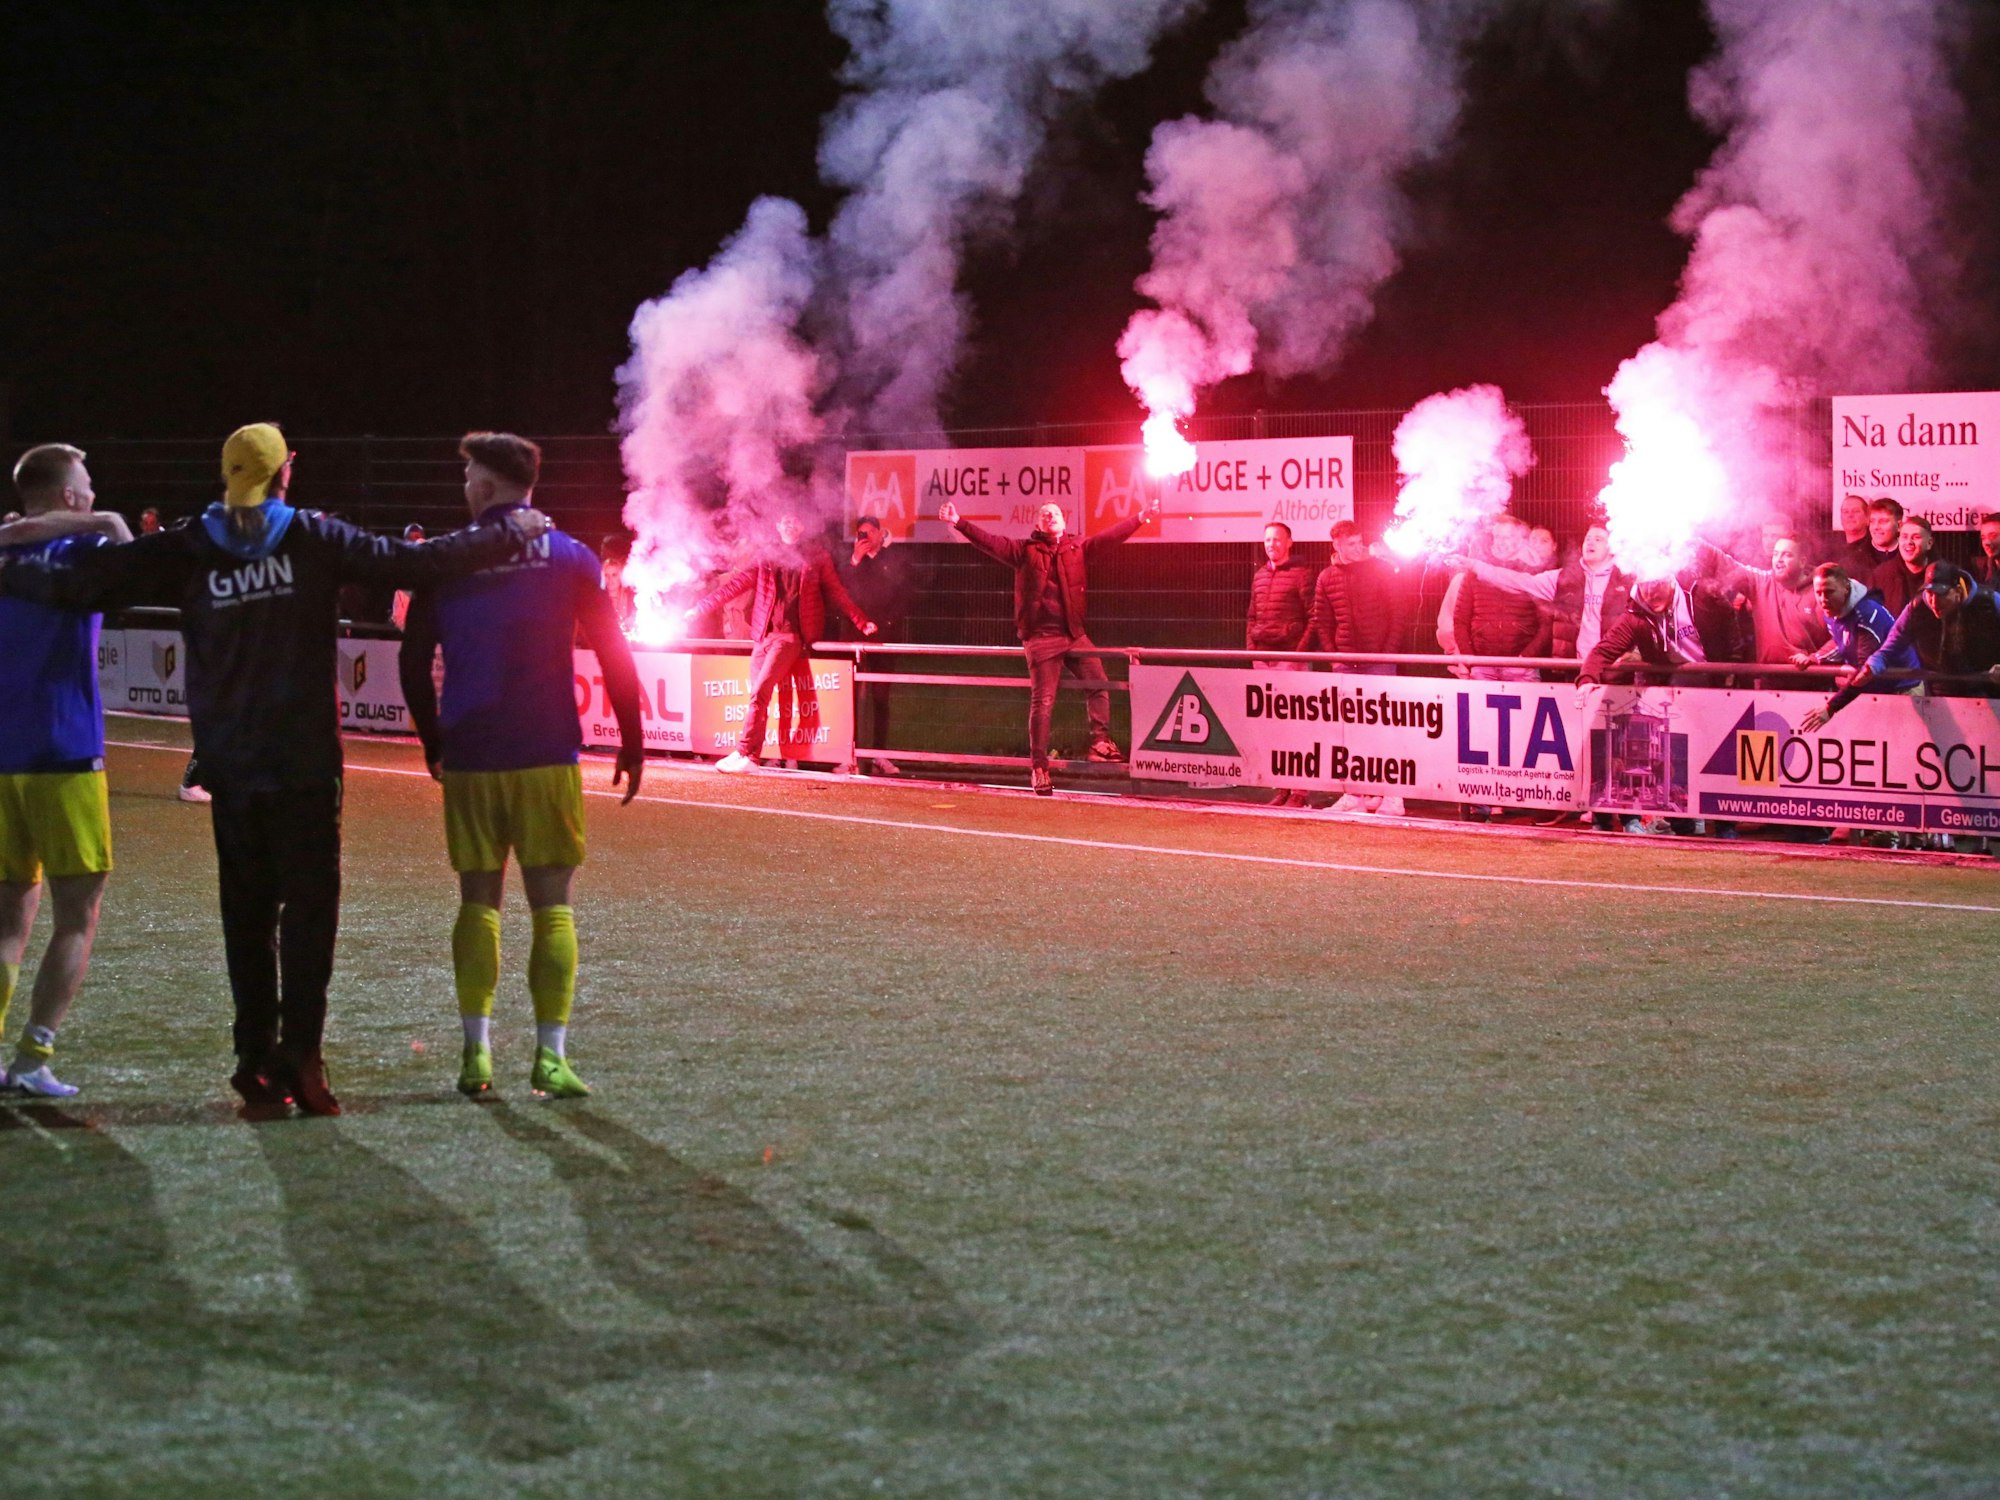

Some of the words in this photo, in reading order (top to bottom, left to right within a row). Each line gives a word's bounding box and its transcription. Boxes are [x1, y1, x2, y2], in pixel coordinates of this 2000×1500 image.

[1842, 415, 1886, 447] Na
[1898, 413, 1979, 447] dann
[929, 467, 990, 497] AUGE
[997, 472, 1010, 495] +
[1018, 466, 1072, 496] OHR
[1177, 460, 1248, 493] AUGE
[1257, 465, 1271, 490] +
[1281, 457, 1344, 489] OHR
[1843, 469, 1866, 488] bis
[1871, 469, 1941, 492] Sonntag
[1009, 503, 1073, 525] Althr
[1272, 500, 1346, 521] Althöfer
[208, 553, 294, 598] GWN
[129, 687, 161, 703] OTTO
[703, 680, 742, 697] TEXTIL
[355, 702, 405, 722] QUAST
[1246, 683, 1443, 739] Dienstleistung
[715, 731, 736, 747] 24H
[1457, 692, 1574, 771] LTA
[1135, 758, 1242, 777] www.berster-bau.de
[1271, 742, 1320, 778] und
[1331, 745, 1416, 785] Bauen
[1741, 729, 1907, 789] MÖBEL
[1458, 765, 1483, 775] Logistik
[1491, 767, 1522, 778] Transport
[1524, 770, 1551, 780] Agentur
[1554, 772, 1575, 781] GmbH
[1458, 782, 1571, 802] www.lta-gmbh.de
[1717, 799, 1905, 823] www.moebel-schuster.de
[1940, 808, 2000, 828] Gewerb
